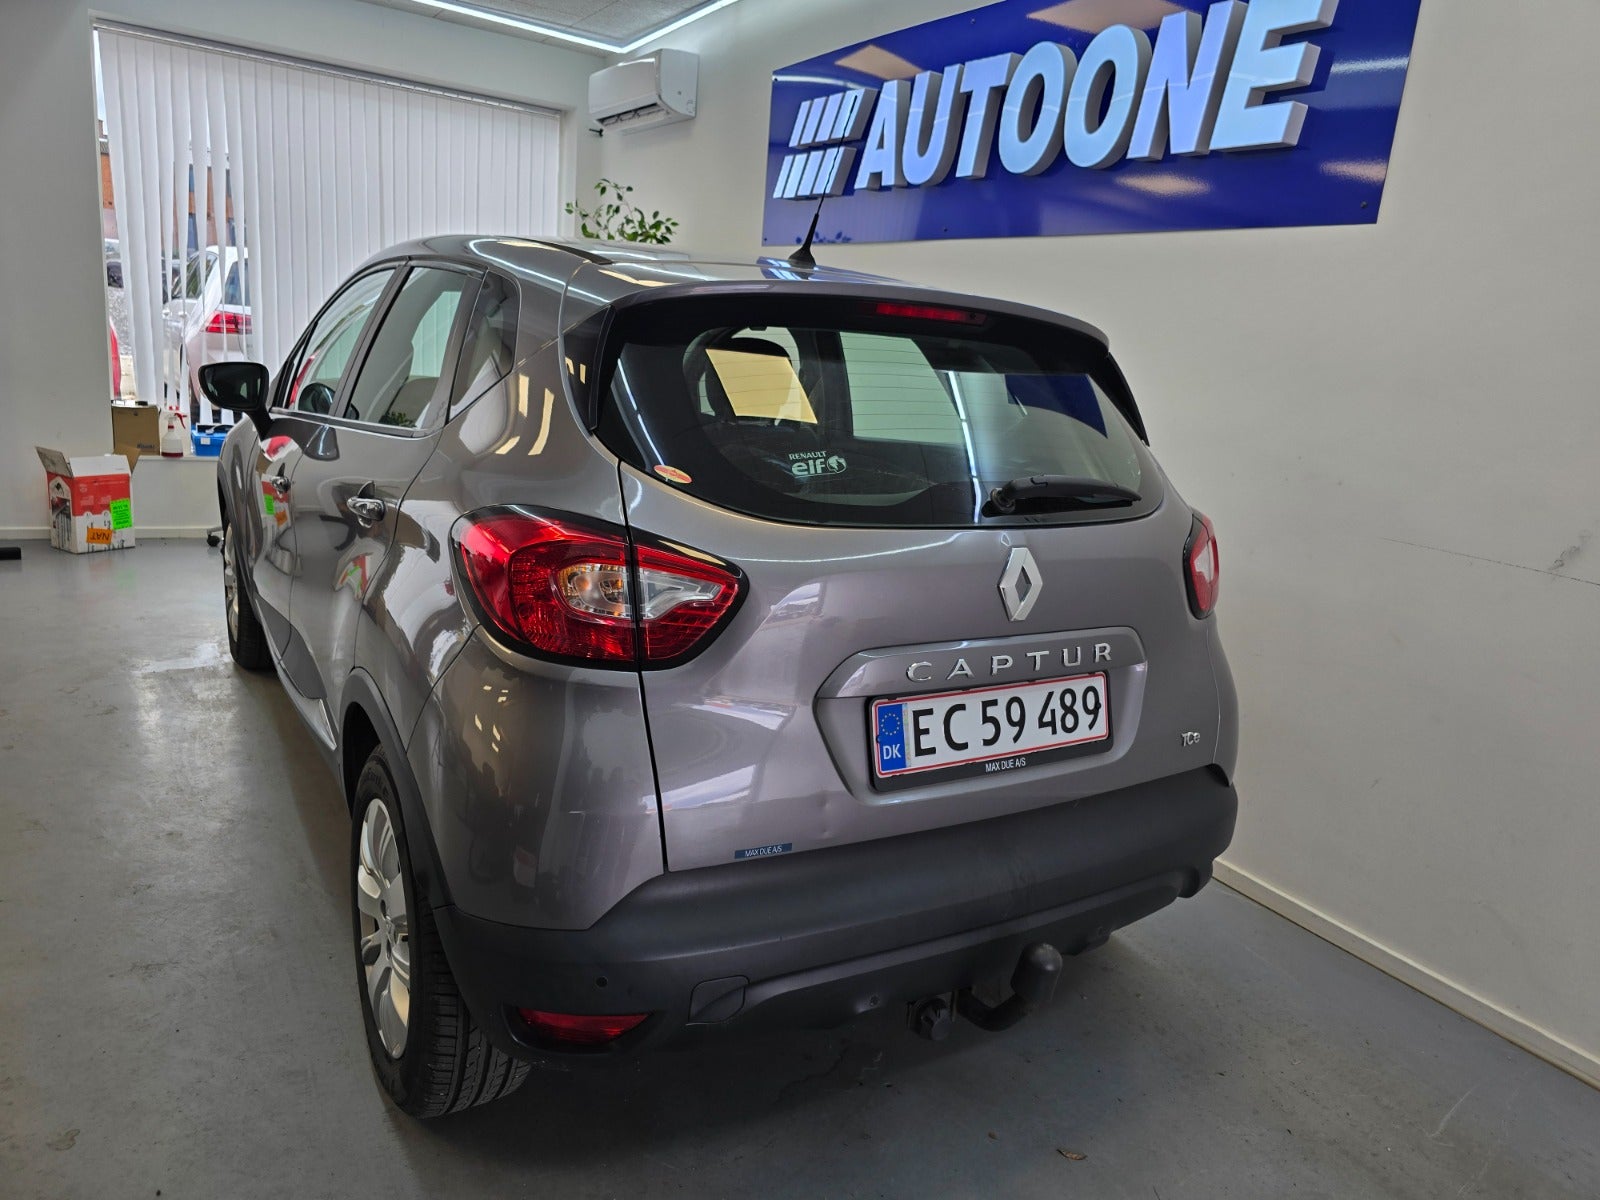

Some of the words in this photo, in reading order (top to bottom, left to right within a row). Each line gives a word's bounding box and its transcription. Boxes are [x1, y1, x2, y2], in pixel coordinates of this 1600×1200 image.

[854, 0, 1338, 190] AUTOONE
[789, 451, 826, 460] RENAULT
[792, 459, 825, 475] elf
[907, 642, 1112, 682] CAPTUR
[912, 704, 969, 757] EC
[981, 696, 1026, 746] 59
[1038, 685, 1101, 735] 489
[883, 743, 901, 760] DK
[985, 762, 1001, 772] MAX
[1001, 759, 1014, 770] DUE
[1015, 757, 1026, 768] A/S
[745, 849, 759, 857] MAX
[760, 846, 772, 855] DUE
